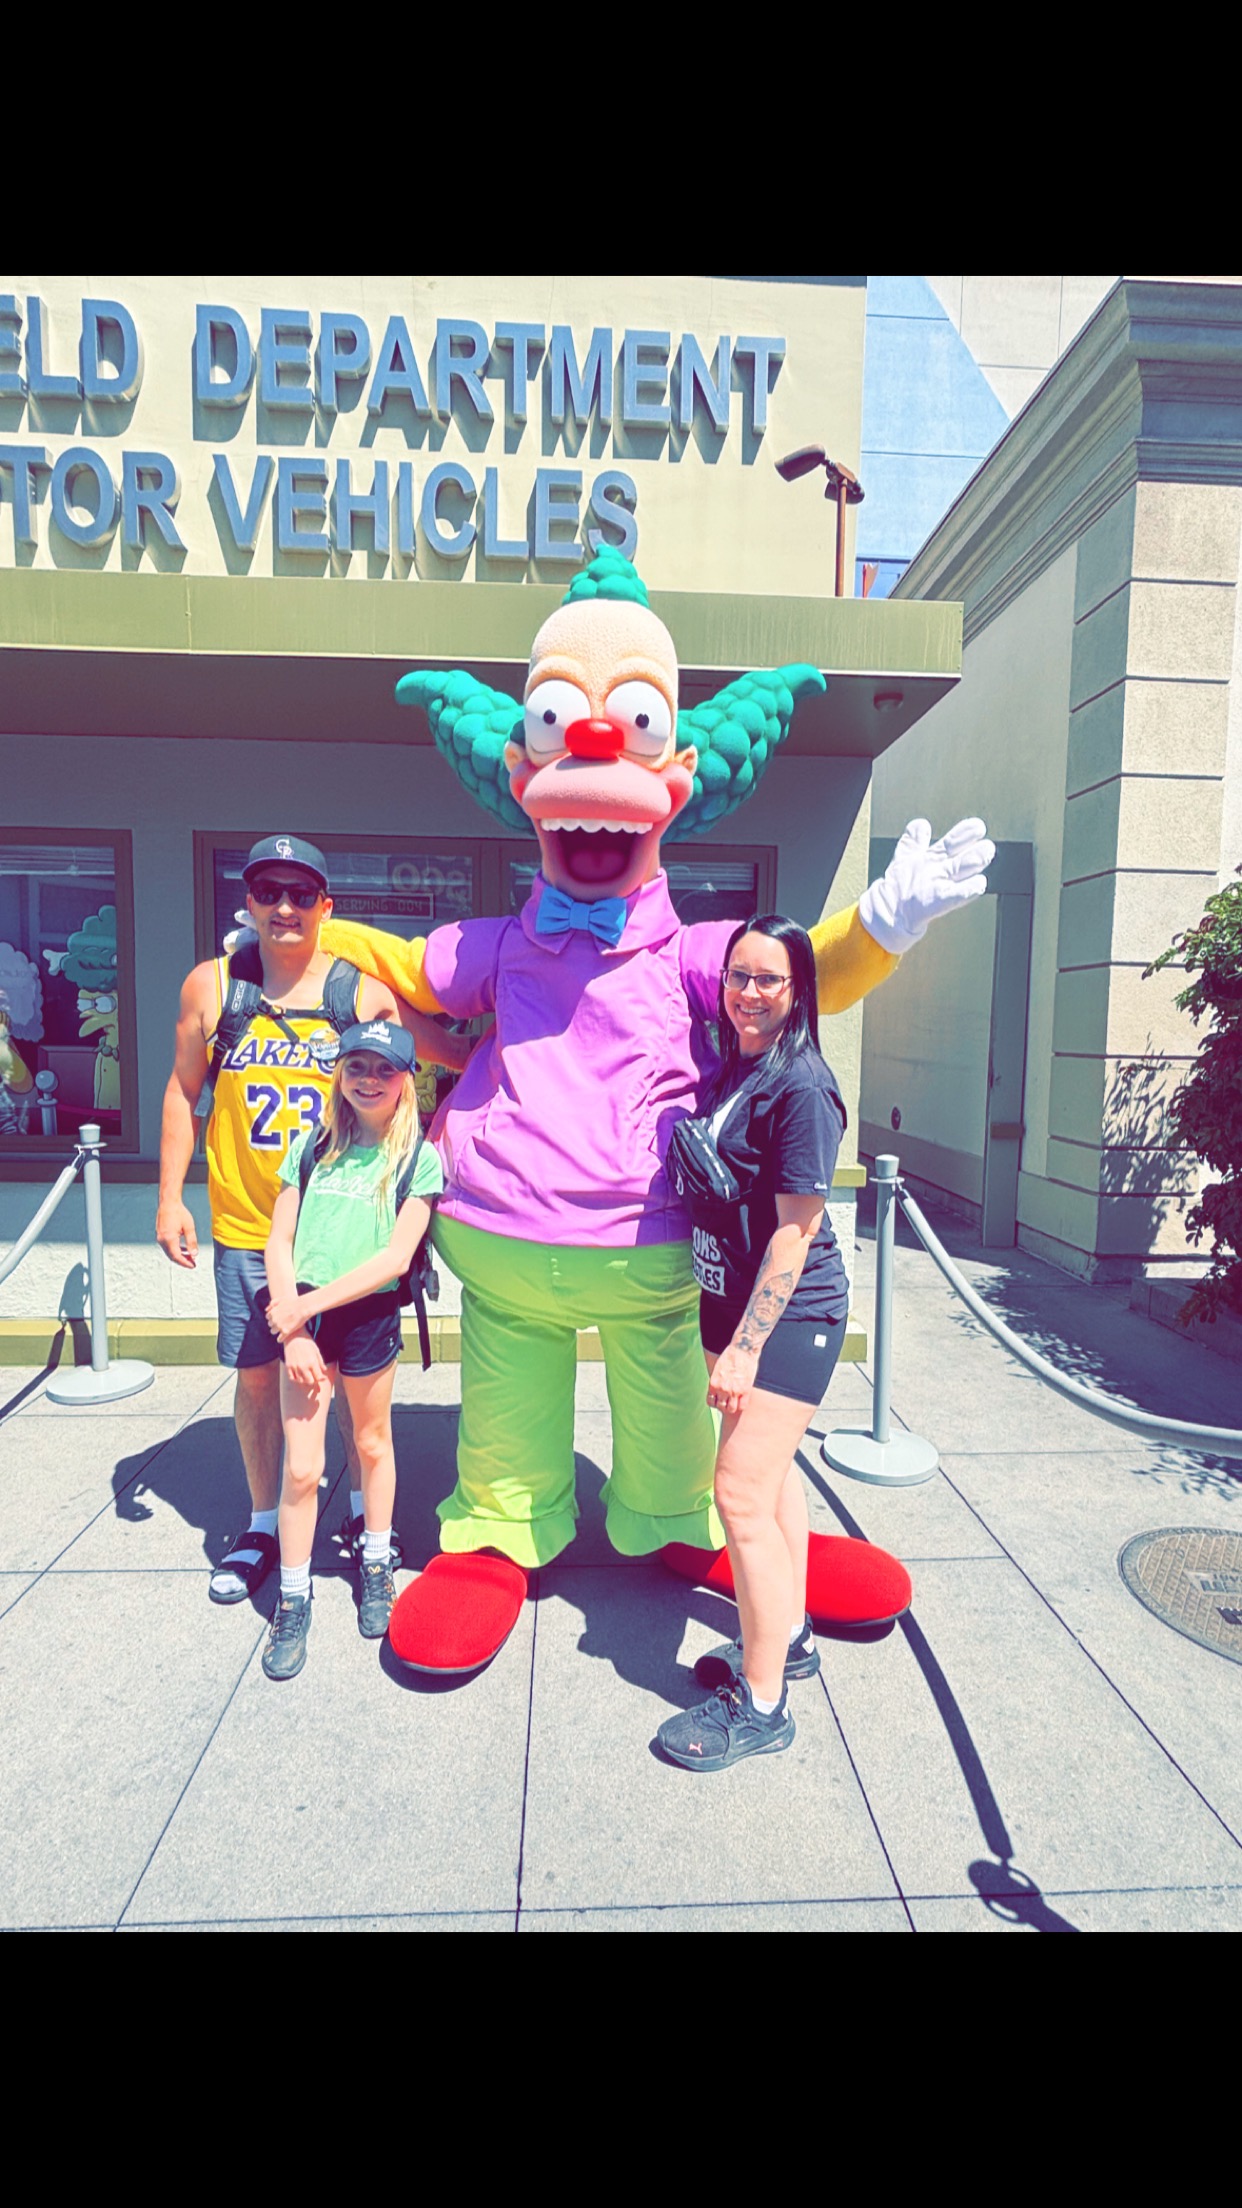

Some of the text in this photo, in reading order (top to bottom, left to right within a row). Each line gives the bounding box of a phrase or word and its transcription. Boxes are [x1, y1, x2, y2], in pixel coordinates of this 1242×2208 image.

[193, 304, 787, 436] DEPARTMENT
[211, 453, 638, 563] VEHICLES
[335, 897, 389, 912] SERVING
[247, 1084, 322, 1147] 23
